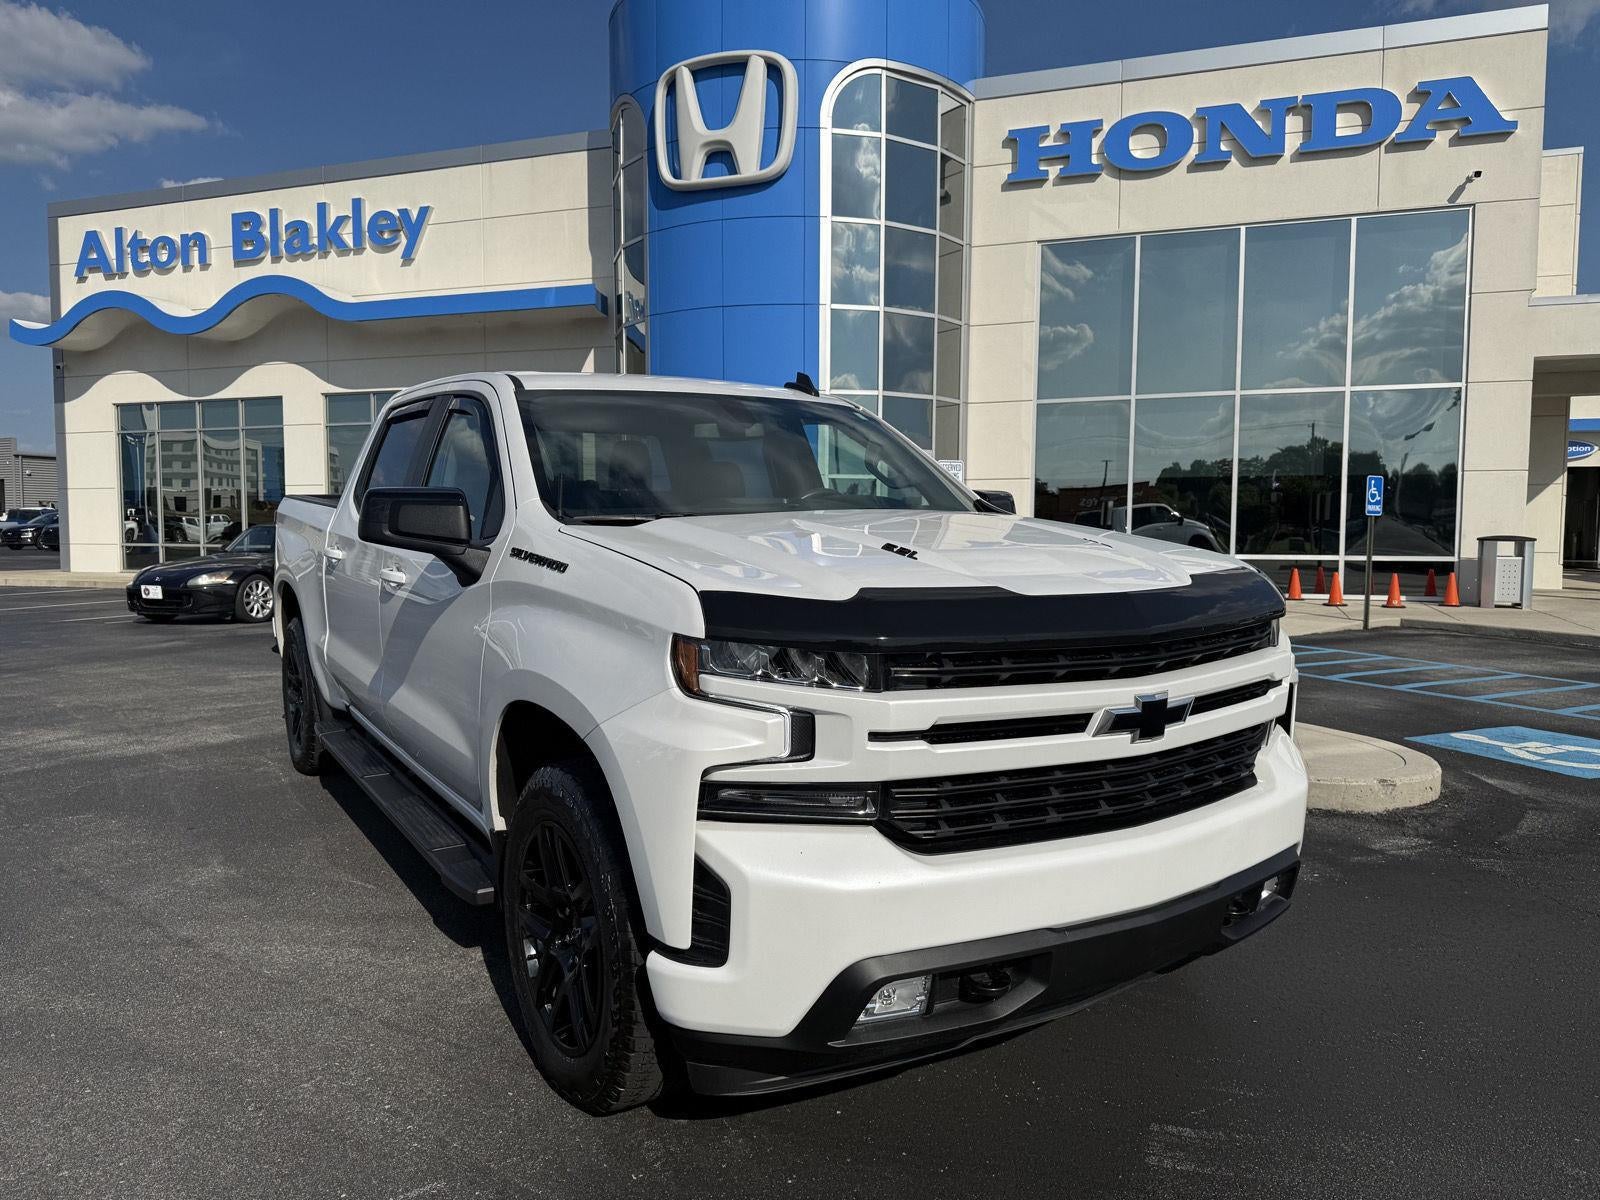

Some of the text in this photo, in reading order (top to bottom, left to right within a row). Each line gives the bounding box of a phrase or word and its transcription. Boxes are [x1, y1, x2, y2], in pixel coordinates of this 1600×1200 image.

[1007, 76, 1519, 182] HONDA
[75, 197, 430, 278] Alton Blakley
[1567, 445, 1591, 453] ption
